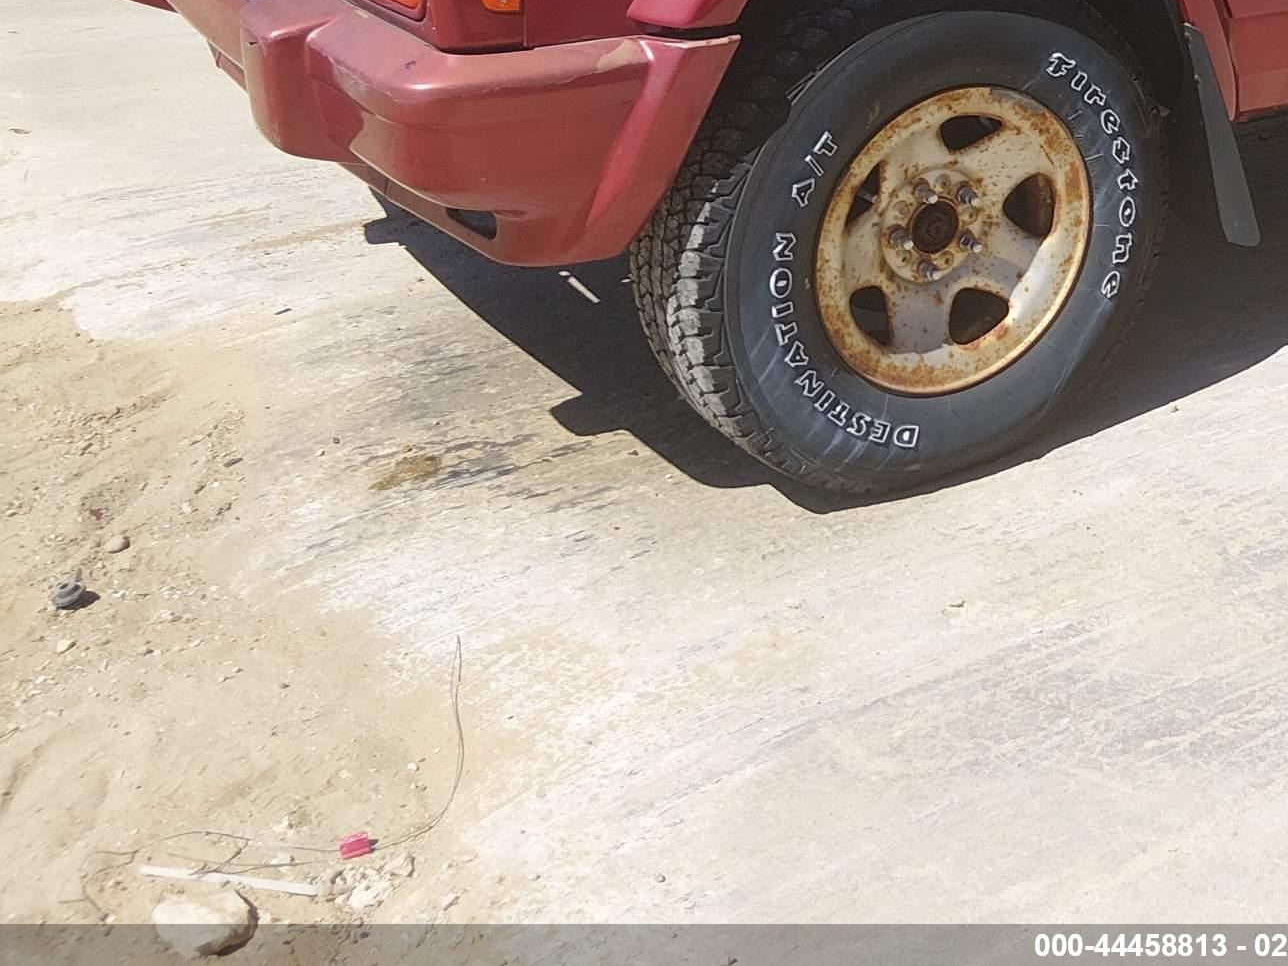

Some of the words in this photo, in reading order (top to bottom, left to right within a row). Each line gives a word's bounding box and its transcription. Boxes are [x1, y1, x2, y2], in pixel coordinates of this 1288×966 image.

[791, 131, 838, 207] A/T
[1047, 52, 1139, 299] Firestone
[770, 232, 919, 448] DESTINATION
